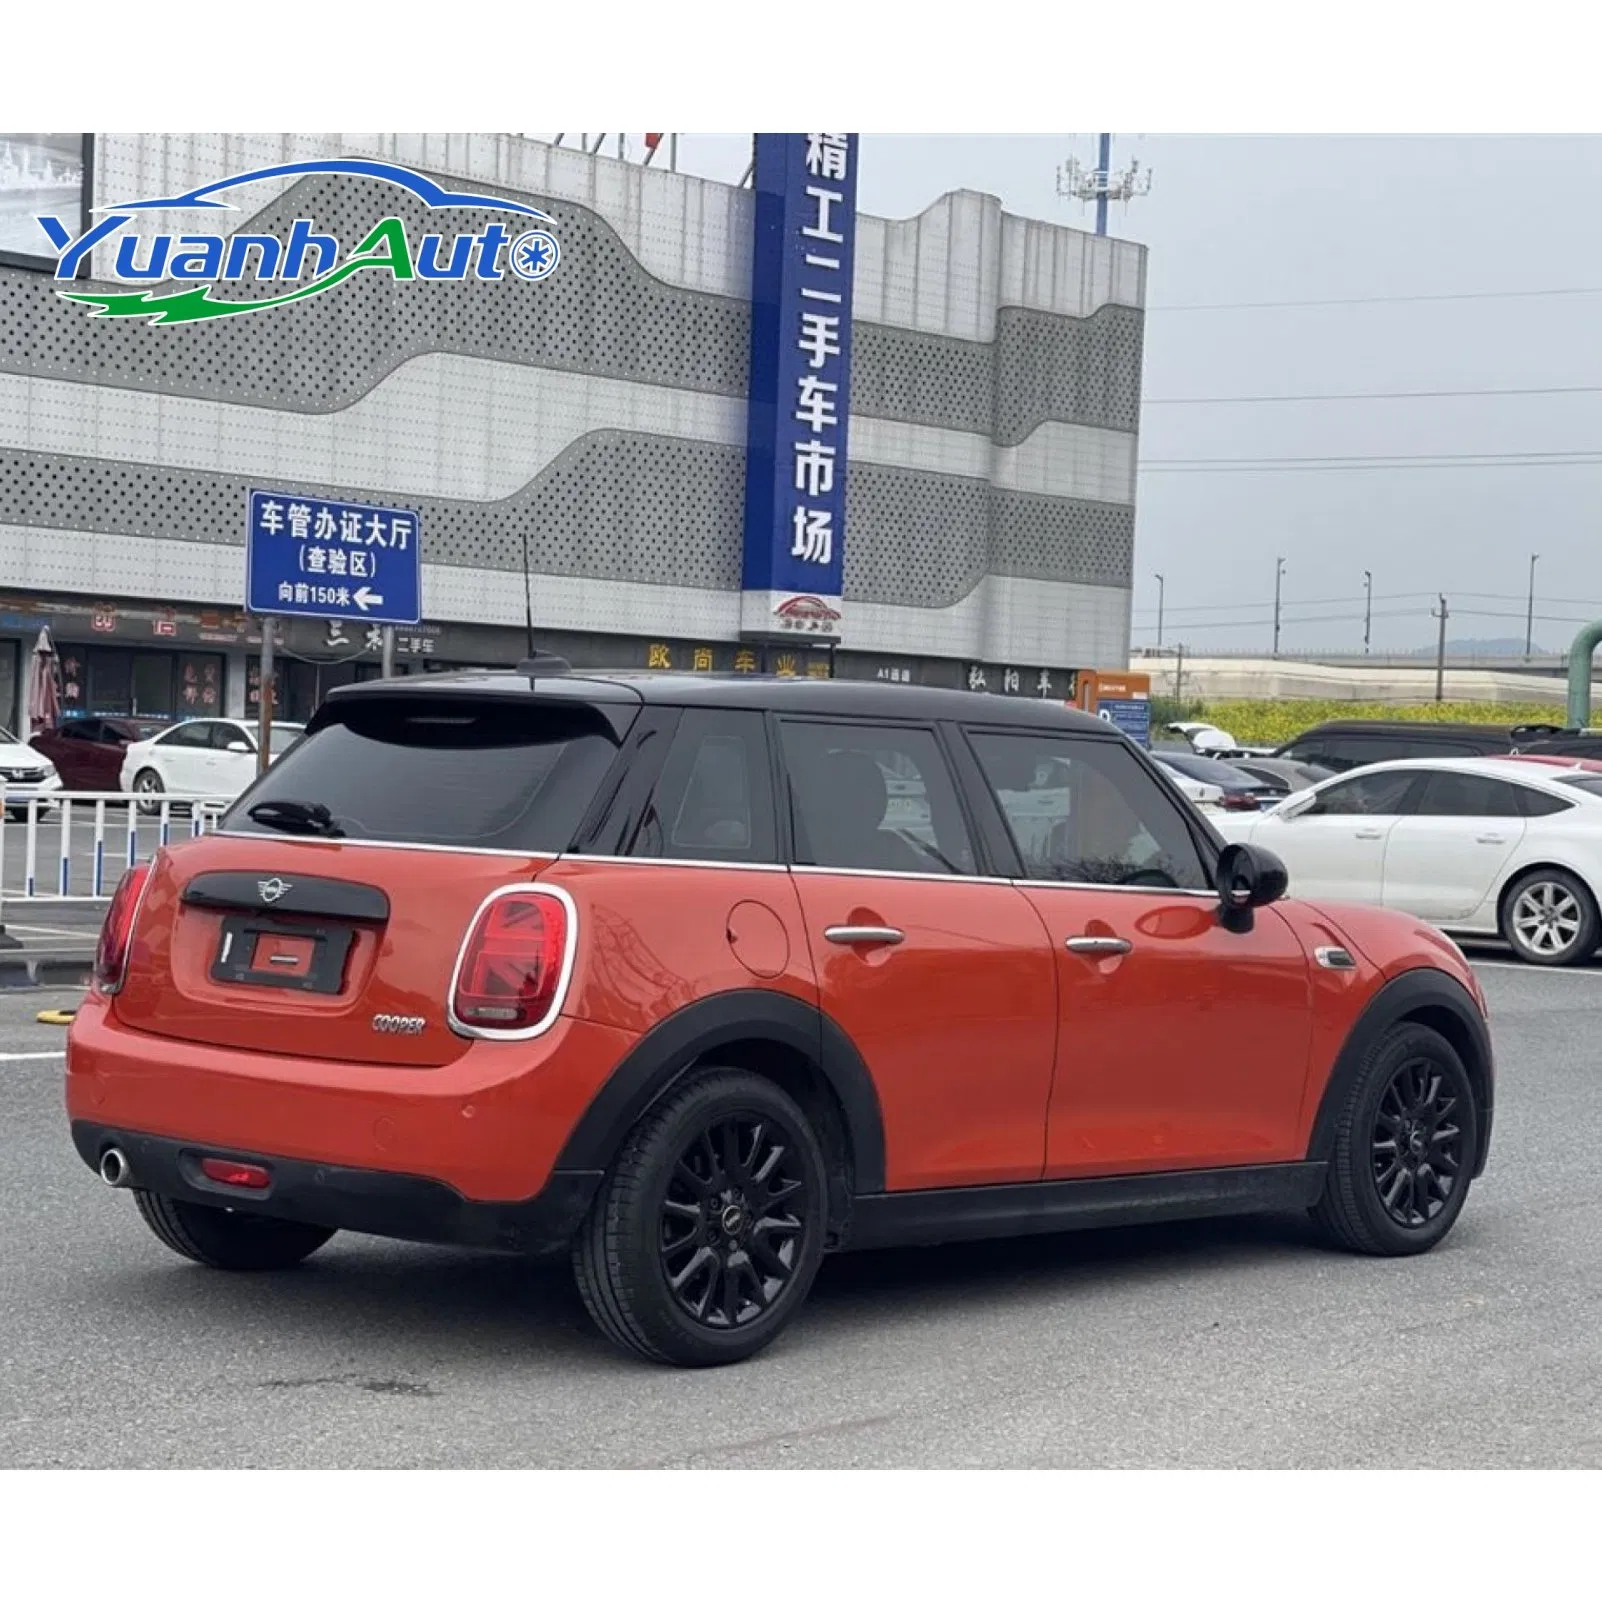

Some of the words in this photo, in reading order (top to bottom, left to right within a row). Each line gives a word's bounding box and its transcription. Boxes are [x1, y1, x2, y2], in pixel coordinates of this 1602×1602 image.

[791, 133, 848, 565] 精工二手车市场
[260, 500, 412, 550] 车管办证大厅
[299, 544, 376, 578] (查验区)
[278, 581, 351, 606] 向前150米
[372, 1014, 425, 1034] COOPER
